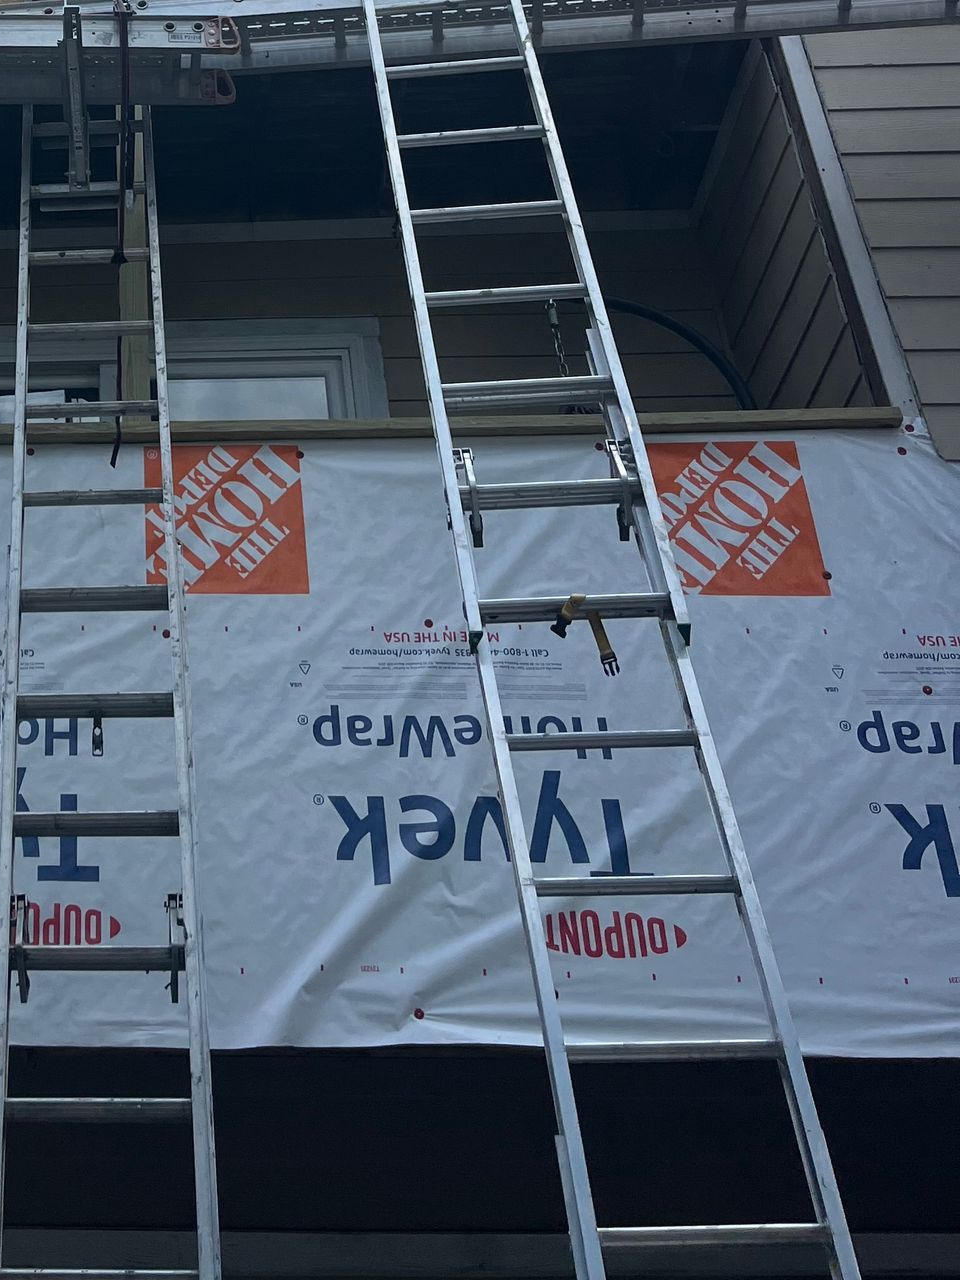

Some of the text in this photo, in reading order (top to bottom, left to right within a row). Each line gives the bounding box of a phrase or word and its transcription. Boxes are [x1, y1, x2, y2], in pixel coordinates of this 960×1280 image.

[659, 441, 733, 532] DEPO
[225, 518, 290, 578] THE
[736, 517, 800, 580] THE
[384, 631, 500, 643] ME IN THE USA
[917, 635, 946, 648] USA
[20, 648, 35, 658] Cal
[349, 647, 450, 659] tyvek.com/homewrap
[532, 647, 549, 658] Call
[546, 909, 669, 959] DUPONT
